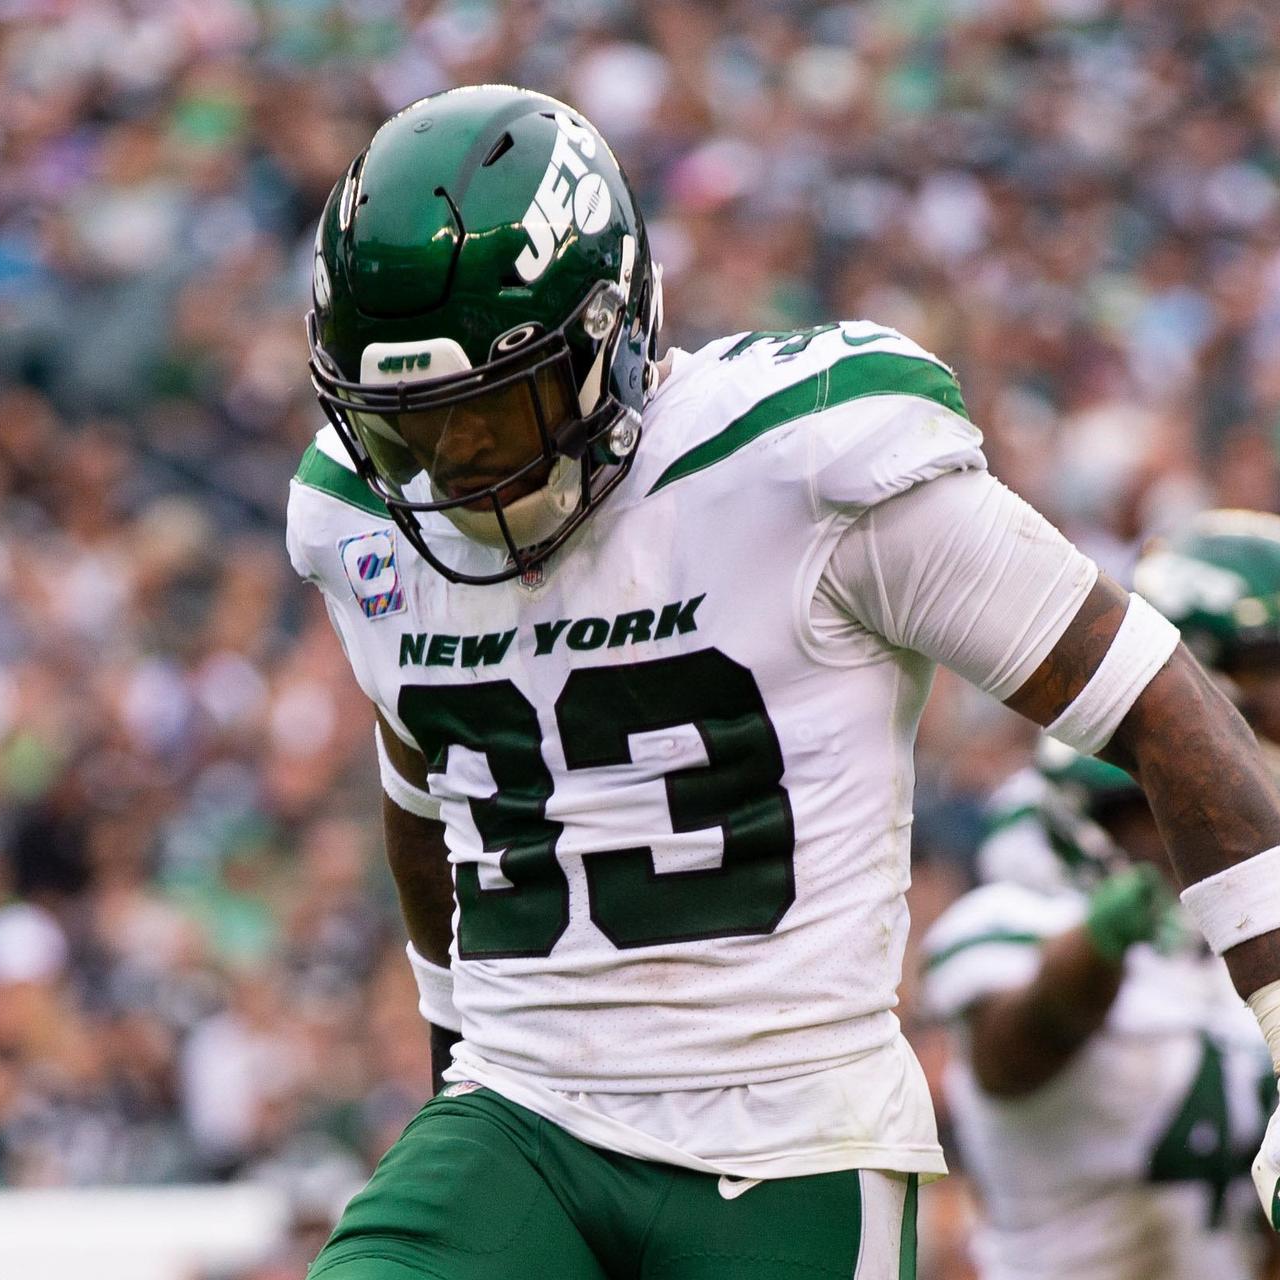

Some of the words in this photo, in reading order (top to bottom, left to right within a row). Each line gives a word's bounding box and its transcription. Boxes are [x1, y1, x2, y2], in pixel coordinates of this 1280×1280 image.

[515, 110, 596, 282] JETS
[377, 352, 431, 374] JETS
[399, 627, 518, 668] NEW
[533, 593, 707, 656] YORK
[397, 646, 796, 961] 33
[1148, 1030, 1278, 1233] 4
